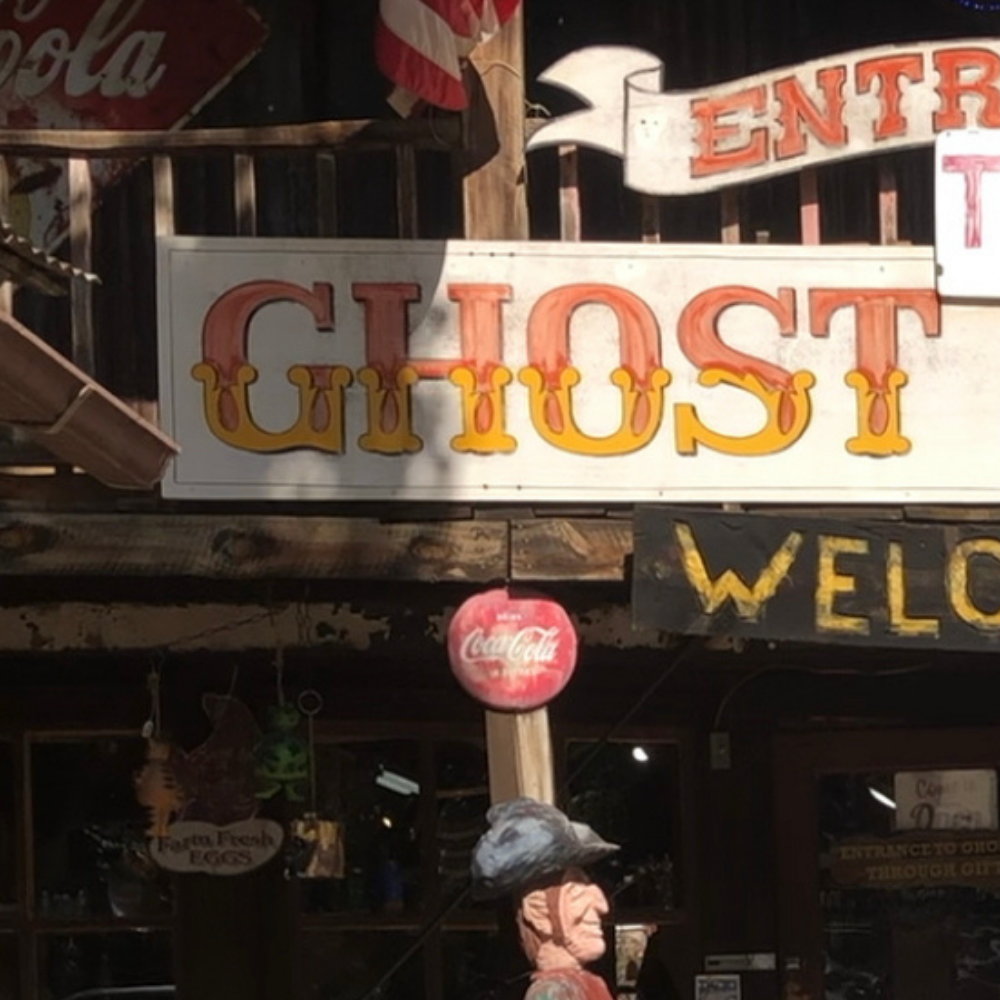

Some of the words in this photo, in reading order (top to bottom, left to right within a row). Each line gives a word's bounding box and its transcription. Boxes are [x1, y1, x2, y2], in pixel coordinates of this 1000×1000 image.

[191, 279, 942, 456] GHOST
[157, 832, 213, 852] Farm
[216, 829, 274, 849] Fresh
[189, 850, 252, 867] EGGS
[840, 843, 932, 860] ENTRANCE
[935, 842, 957, 856] TO
[866, 863, 957, 881] THROUGH
